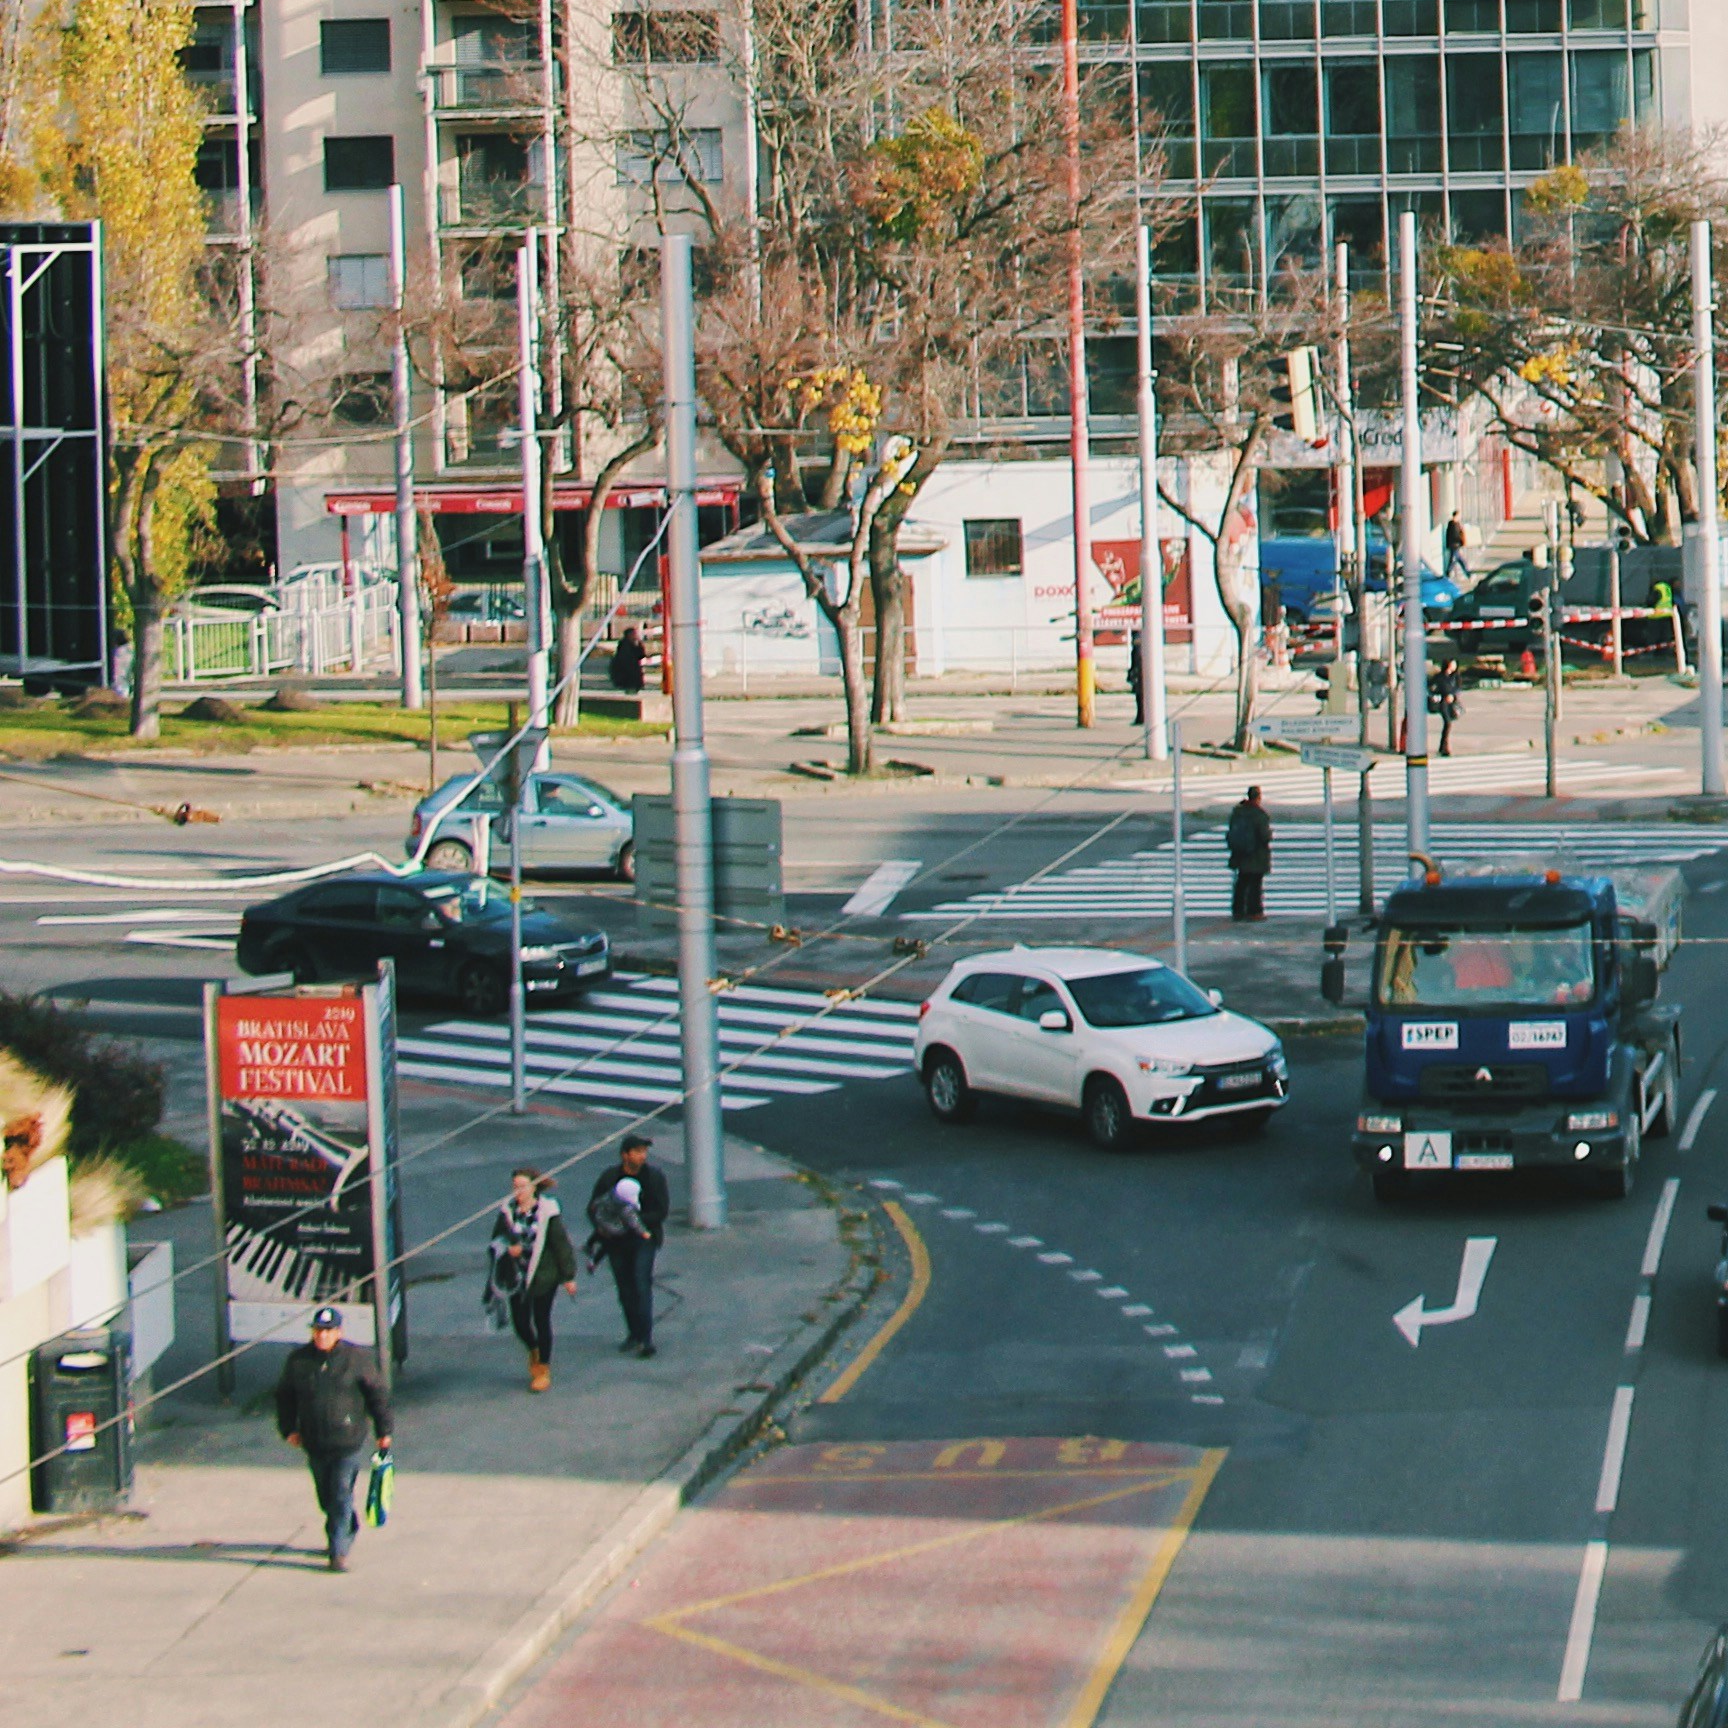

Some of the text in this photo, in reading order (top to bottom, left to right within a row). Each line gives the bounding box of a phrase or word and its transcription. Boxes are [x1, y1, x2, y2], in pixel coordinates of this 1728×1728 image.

[324, 1006, 355, 1022] 2019
[237, 1019, 350, 1040] BRATISLAVA
[239, 1040, 350, 1067] MOZART
[239, 1068, 353, 1095] FESTIVAL
[1418, 1136, 1438, 1164] A
[810, 1435, 1129, 1471] BUS
